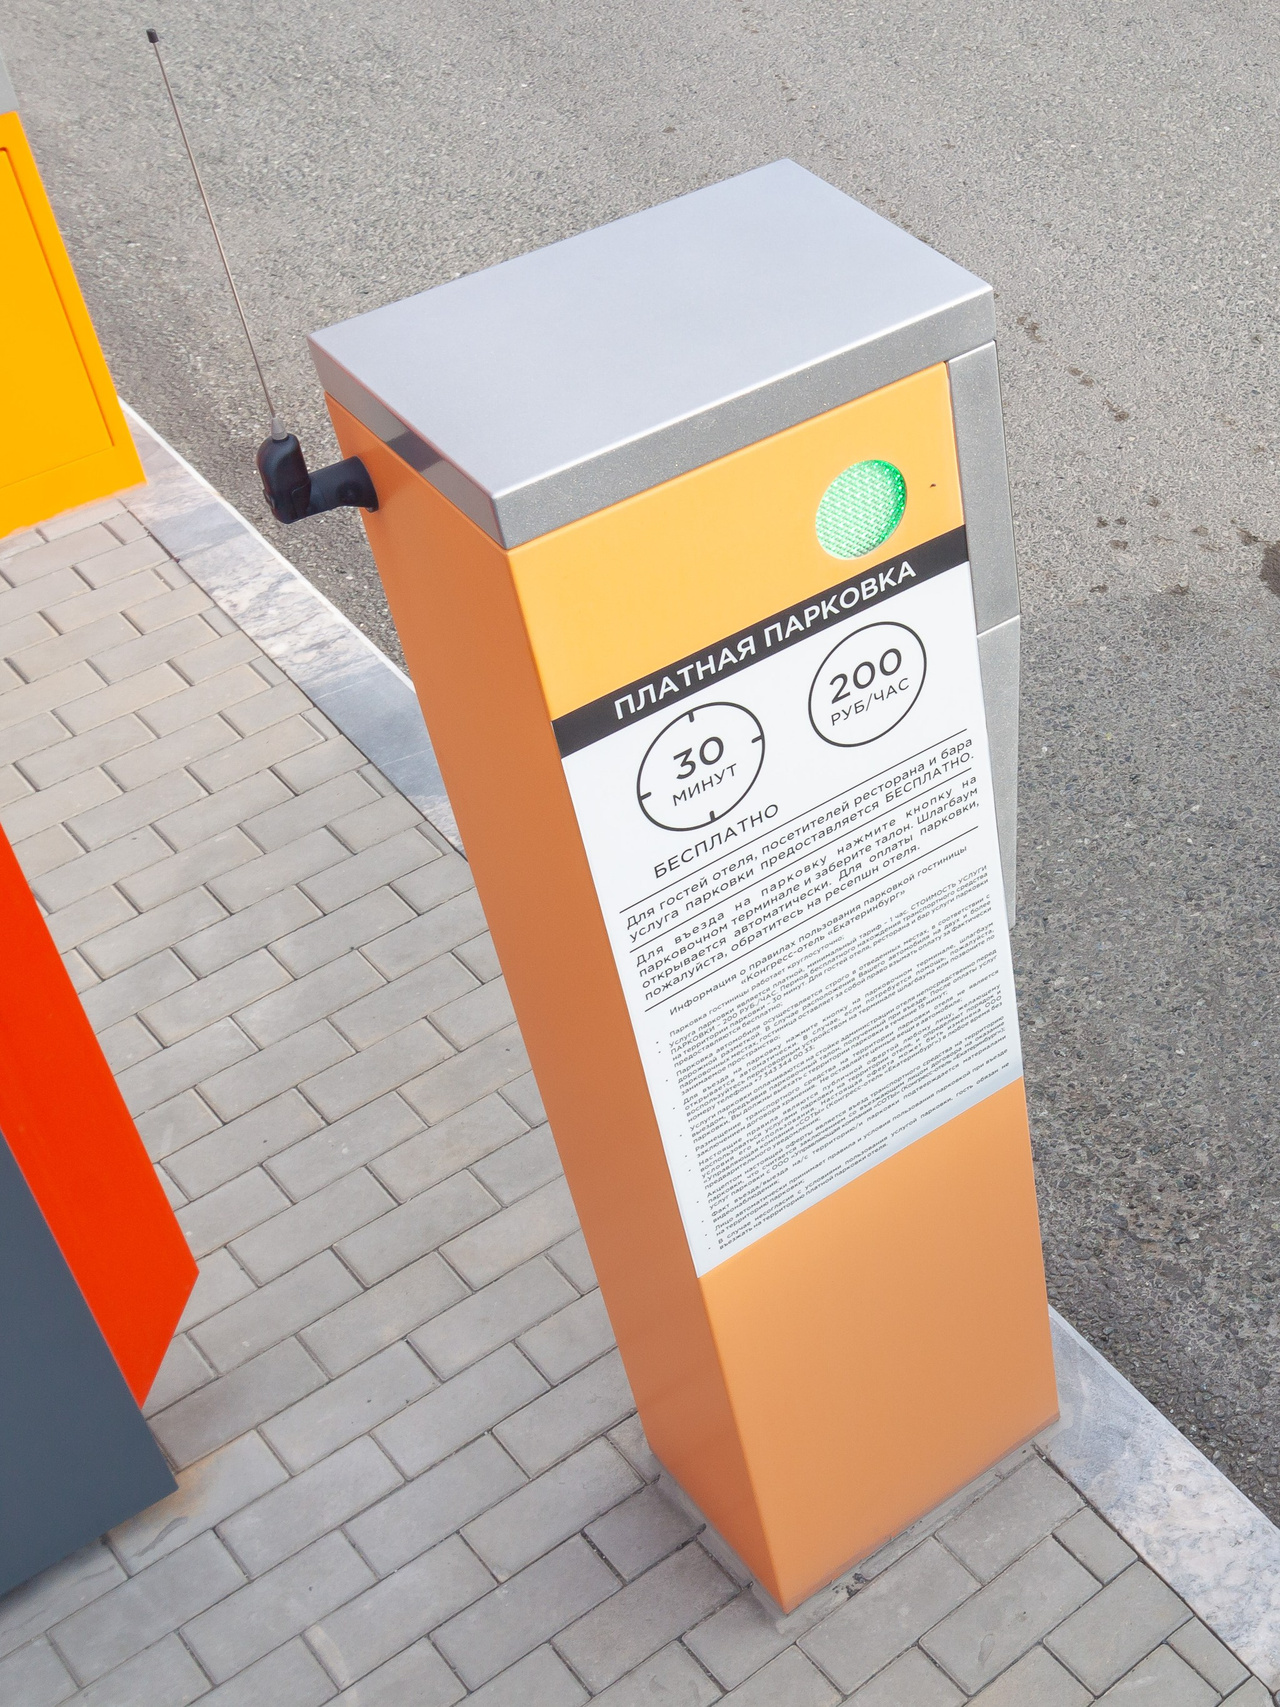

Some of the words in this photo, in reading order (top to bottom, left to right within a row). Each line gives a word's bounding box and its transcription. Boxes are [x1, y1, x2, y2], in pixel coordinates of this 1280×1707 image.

[613, 635, 756, 720] ПЛАТНАЯ
[763, 560, 917, 648] ПАРКОВКА
[829, 647, 902, 705] 200
[831, 677, 910, 726] РУБ/ЧАС
[626, 906, 656, 931] Для
[659, 876, 709, 911] гостей
[712, 853, 758, 881] отеля,
[761, 800, 850, 855] посетителей
[853, 763, 925, 808] ресторана
[928, 756, 937, 767] и
[940, 738, 973, 760] бара
[672, 763, 737, 807] МИНУТ
[673, 736, 725, 780] 30
[629, 909, 680, 944] услуга
[685, 867, 755, 911] парковки
[760, 800, 880, 871] предоставляется
[884, 751, 974, 804] БЕСПЛАТНО.
[636, 945, 664, 968] Для
[674, 912, 725, 945] въезда
[734, 897, 751, 912] на
[760, 855, 827, 897] парковку
[836, 818, 896, 856] нажмите
[905, 788, 953, 819] кнопку
[961, 776, 977, 789] на
[638, 922, 728, 978] парковочном
[730, 883, 801, 926] терминале
[803, 876, 812, 887] и
[814, 844, 872, 881] заберите
[874, 823, 914, 847] талон.
[916, 787, 978, 825] Шлагбаум
[641, 936, 727, 989] открывается
[733, 880, 832, 938] автоматически.
[838, 862, 863, 882] Для
[868, 834, 914, 863] оплаты
[919, 800, 980, 836] парковки,
[653, 804, 779, 879] БЕСПЛАТНО
[644, 951, 728, 1001] пожалуйста,
[730, 908, 804, 952] обратитесь
[806, 897, 822, 910] на
[824, 865, 880, 902] ресепшн
[882, 844, 921, 868] отеля.
[669, 973, 738, 1016] Информация
[739, 968, 747, 976] о
[748, 940, 797, 971] правилах
[798, 903, 862, 943] пользования
[863, 873, 916, 907] парковкой
[917, 845, 968, 877] гостиницы
[740, 935, 826, 985] «Конгресс-отель
[827, 889, 906, 936] «Екатеринбург»
